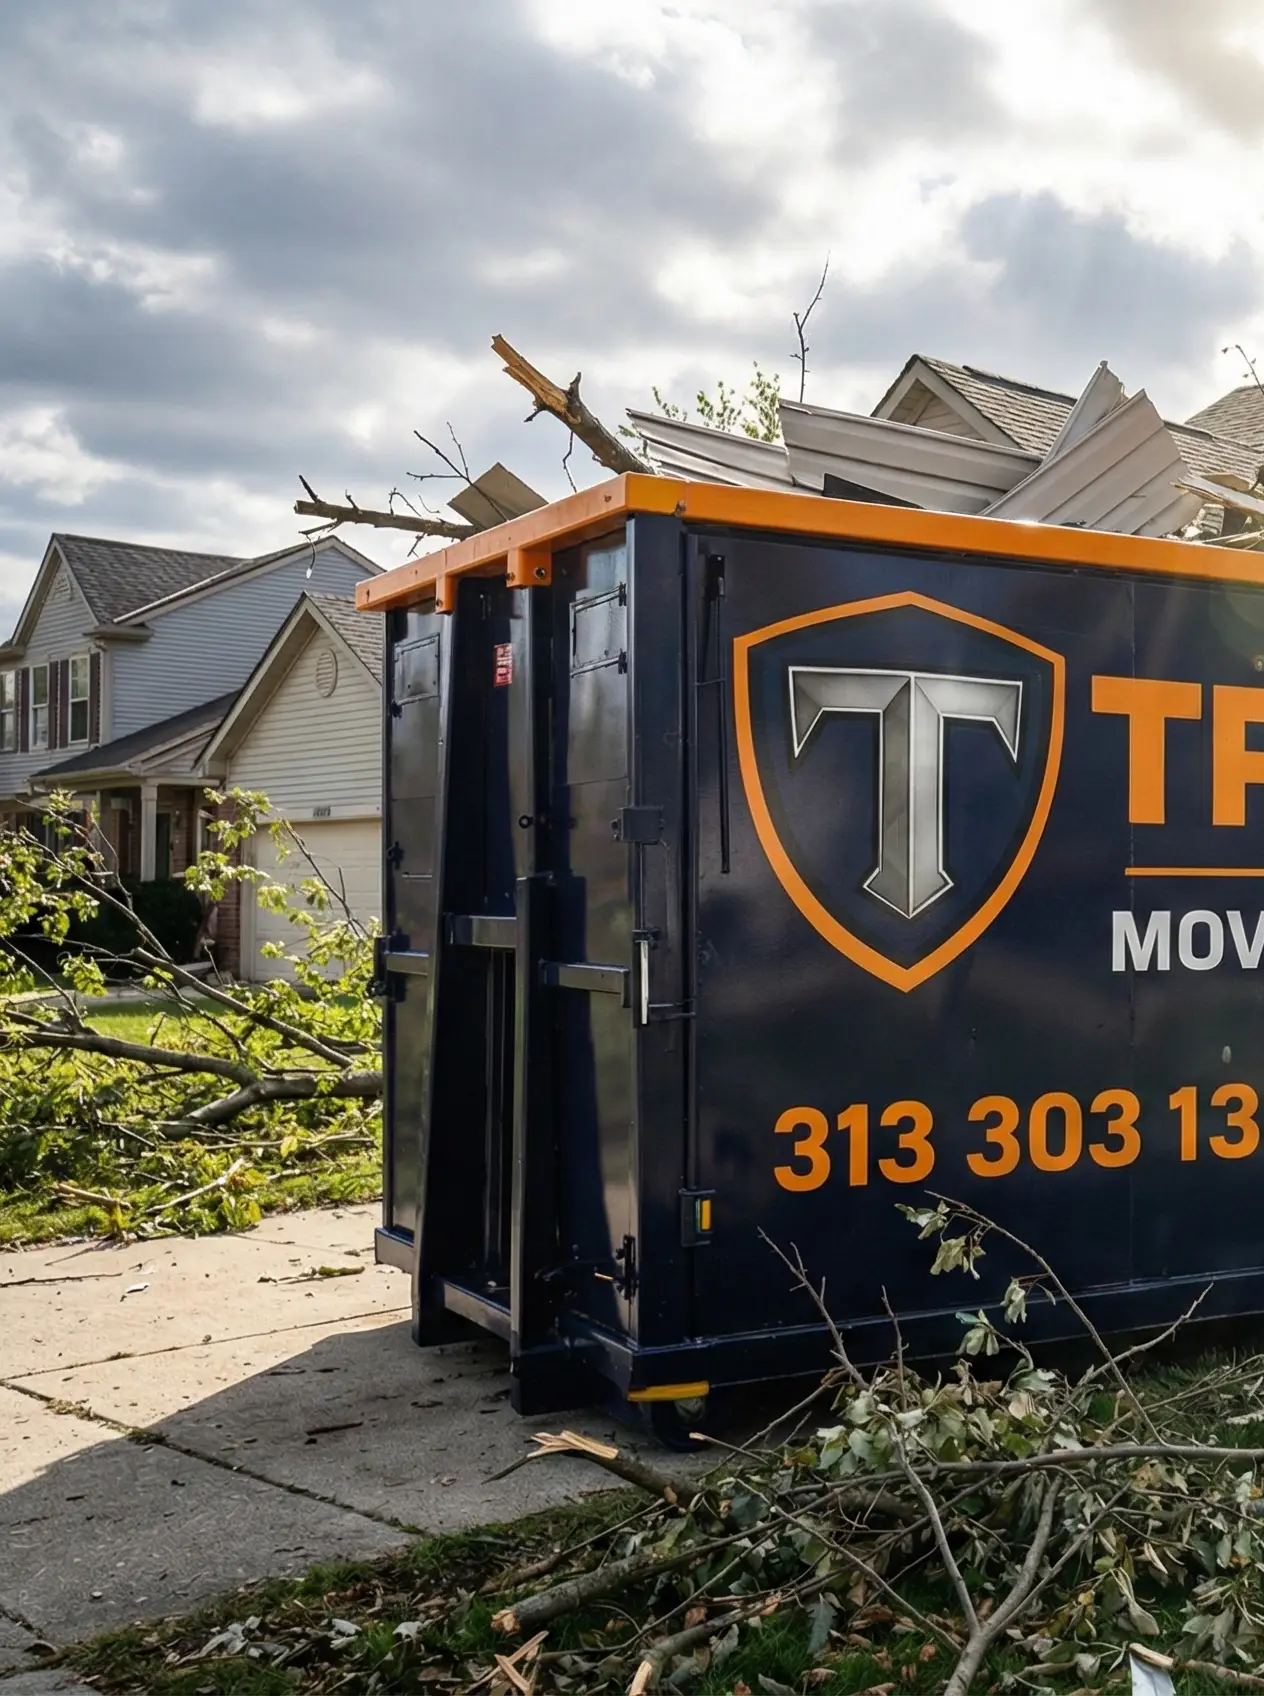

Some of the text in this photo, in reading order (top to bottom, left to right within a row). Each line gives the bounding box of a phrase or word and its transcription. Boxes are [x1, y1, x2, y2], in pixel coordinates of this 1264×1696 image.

[787, 665, 1023, 920] T
[773, 1100, 935, 1192] 313
[967, 1088, 1141, 1178] 303
